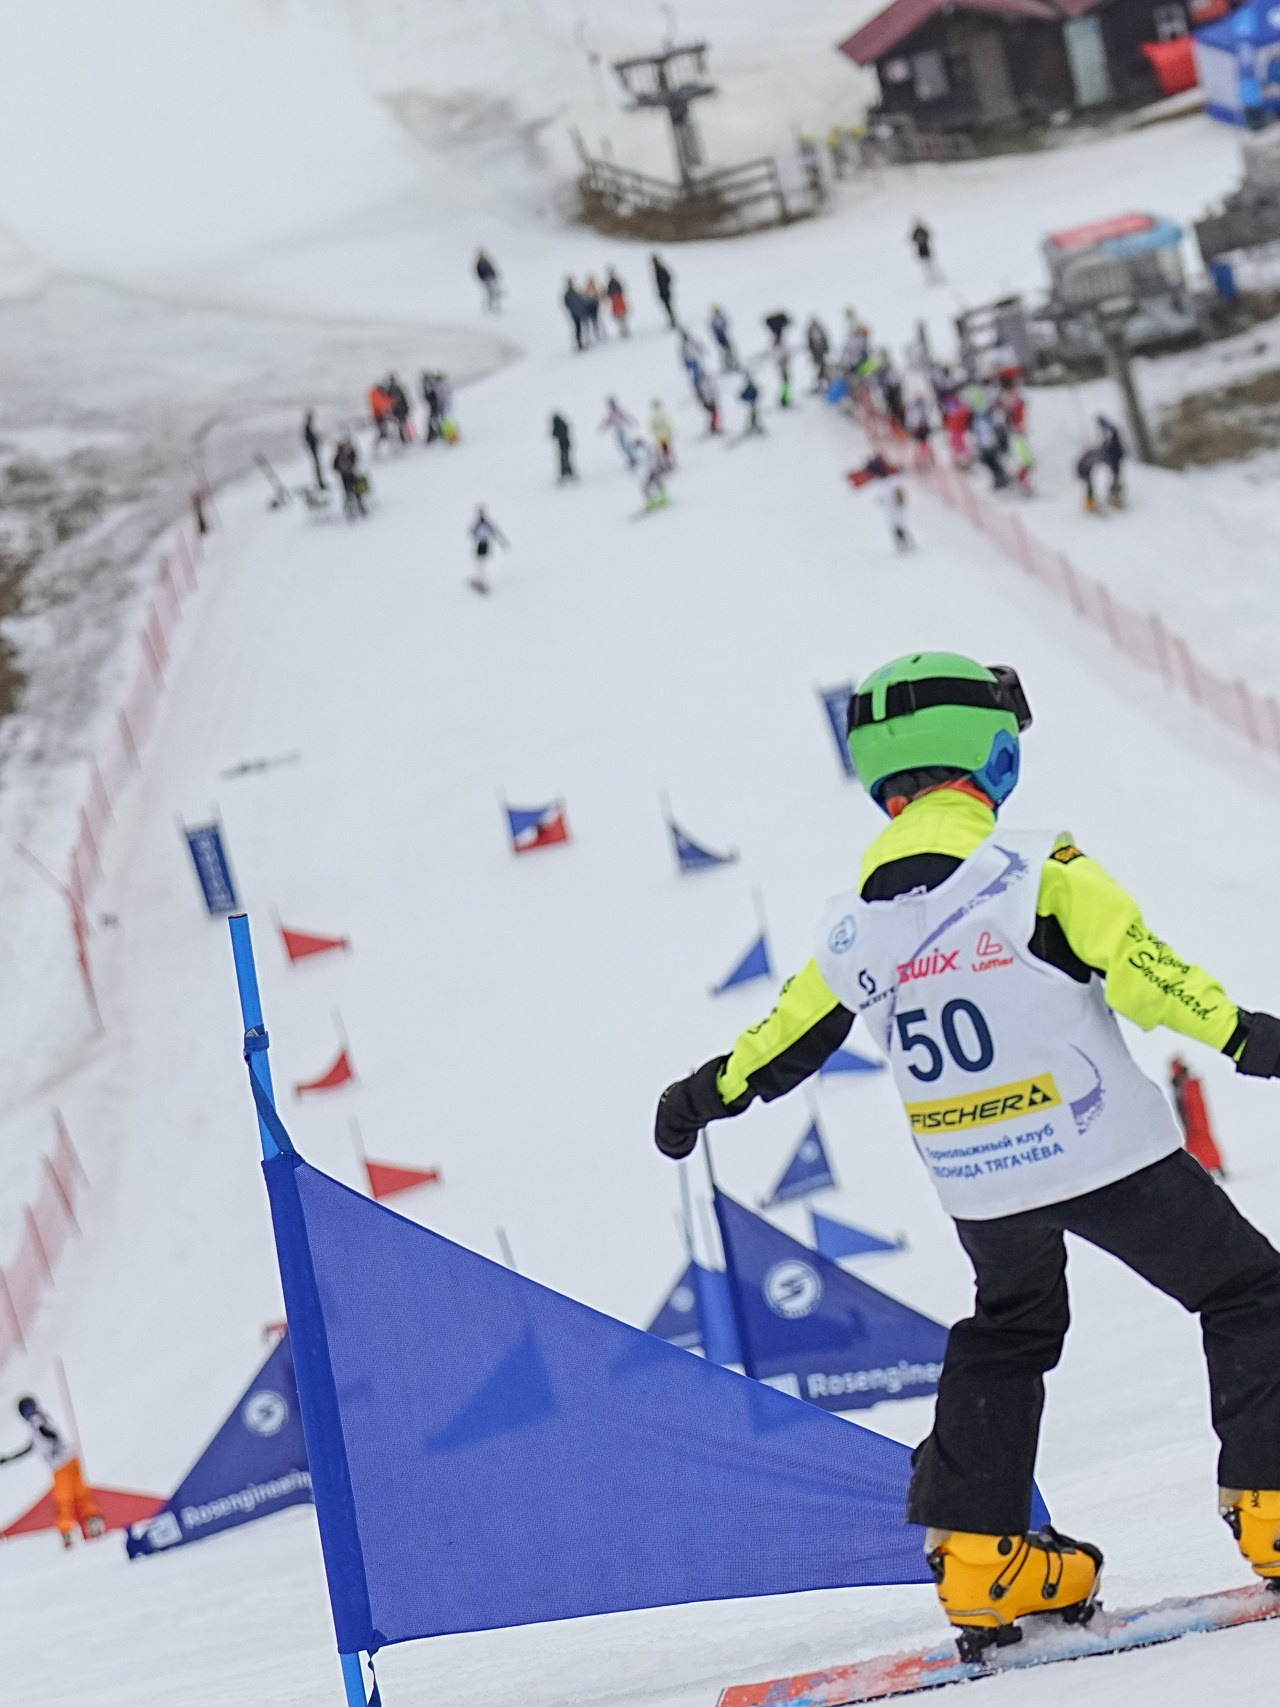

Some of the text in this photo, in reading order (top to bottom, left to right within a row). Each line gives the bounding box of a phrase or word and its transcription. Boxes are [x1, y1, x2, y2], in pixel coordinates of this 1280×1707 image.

[896, 998, 993, 1082] 50
[911, 1095, 1023, 1128] FISCHER
[1015, 1123, 1054, 1147] клуб
